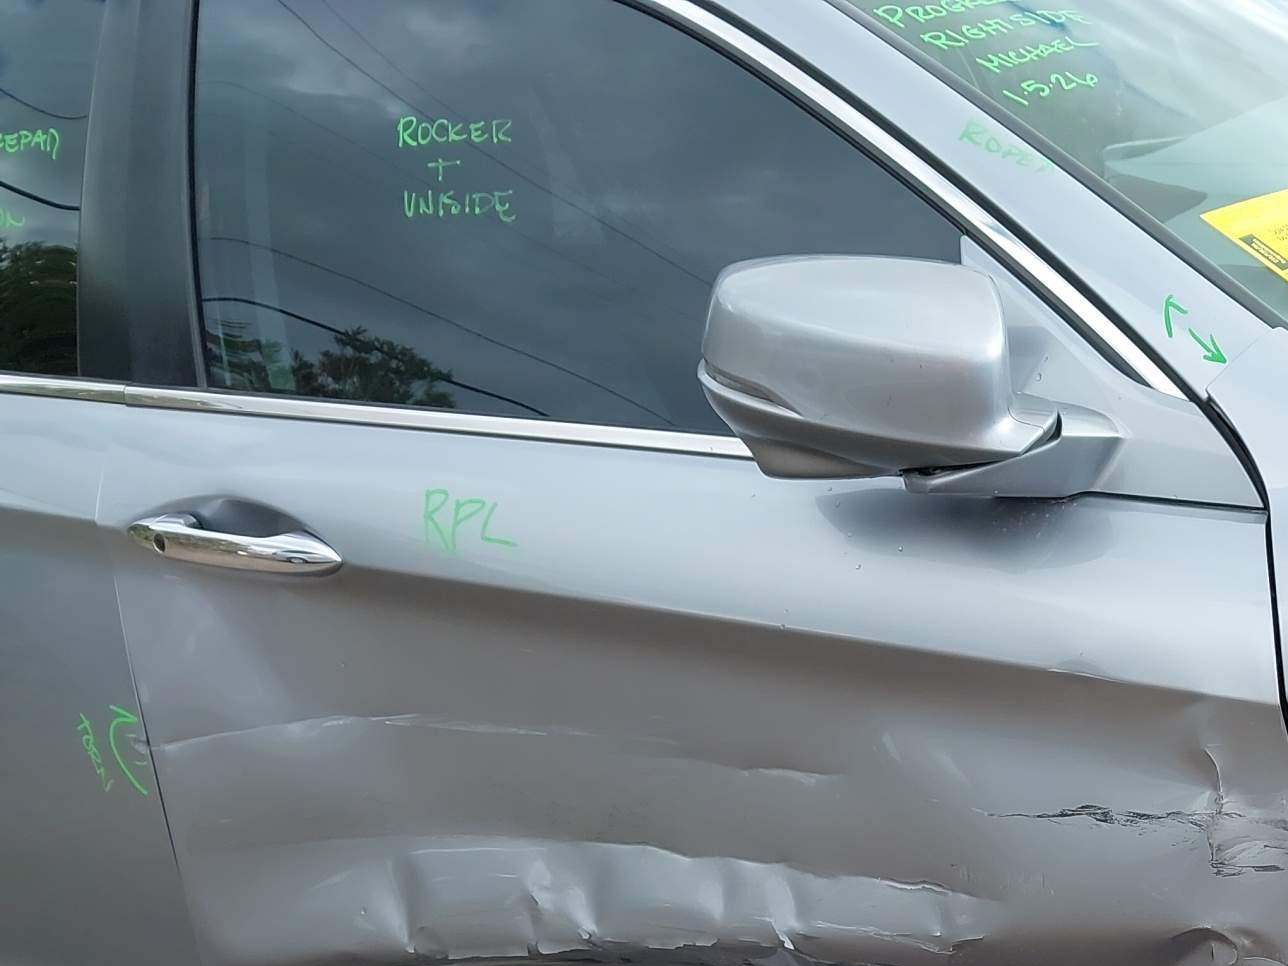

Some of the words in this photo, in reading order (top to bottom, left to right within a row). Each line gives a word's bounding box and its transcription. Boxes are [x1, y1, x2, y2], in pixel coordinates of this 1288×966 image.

[920, 18, 1014, 49] RIGHT
[976, 36, 1099, 73] MICHAEL
[397, 116, 512, 148] ROCKER
[423, 487, 519, 554] RPL
